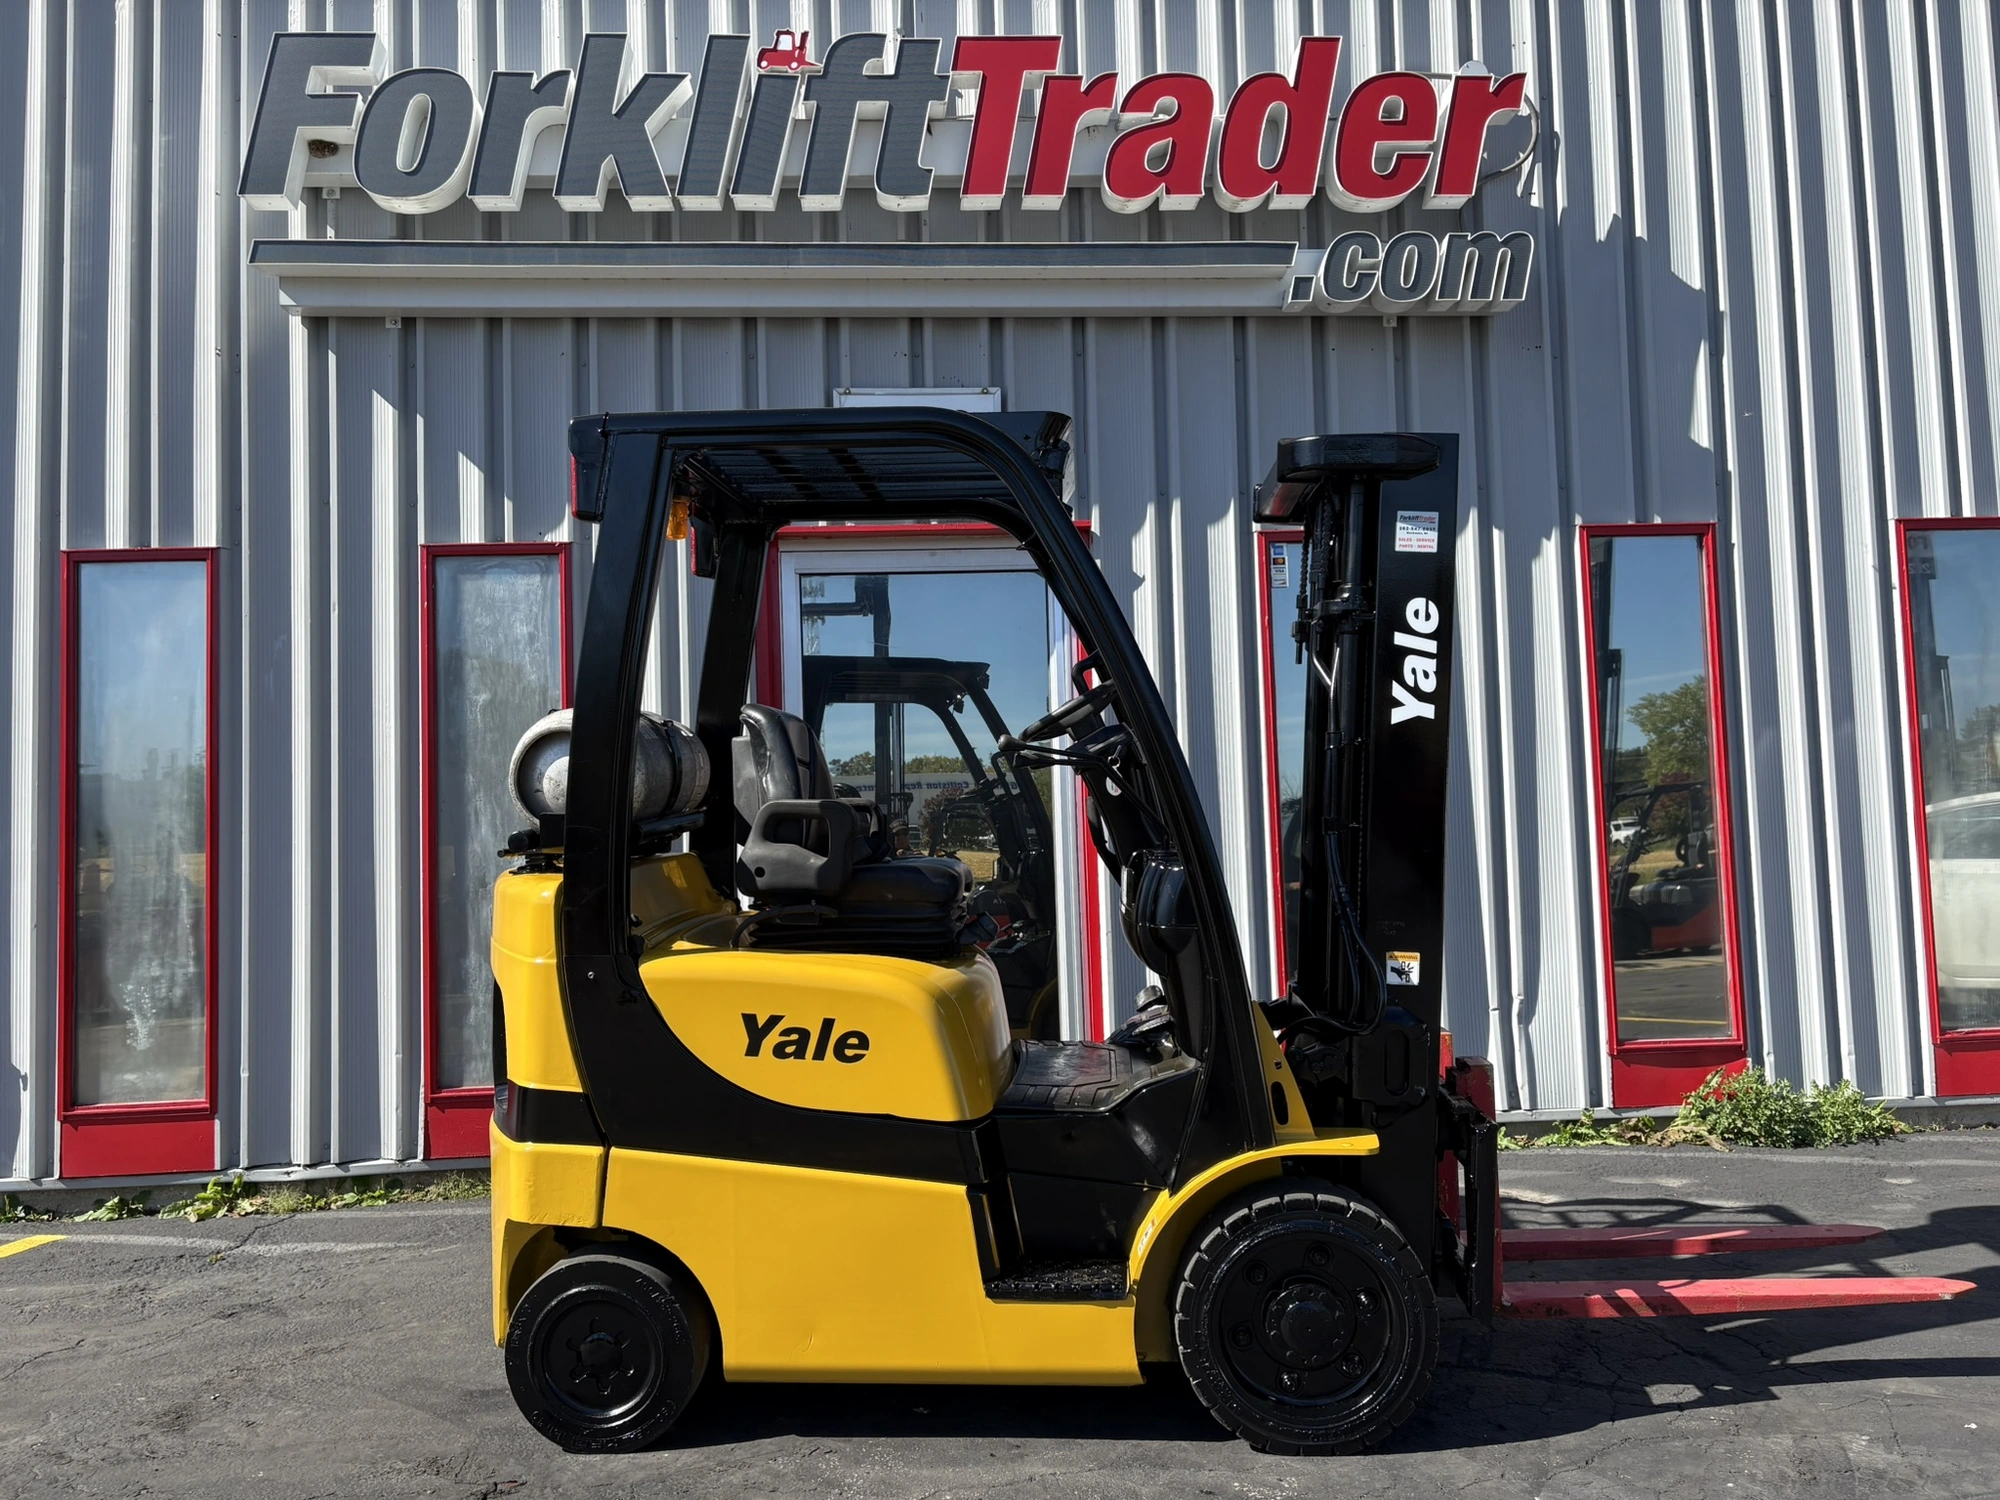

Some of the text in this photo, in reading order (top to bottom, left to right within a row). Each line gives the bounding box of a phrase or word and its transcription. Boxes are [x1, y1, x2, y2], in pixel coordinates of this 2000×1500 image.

[238, 29, 1528, 208] ForkliftTrader
[1286, 229, 1535, 306] .com
[1391, 597, 1440, 725] Yale
[740, 1012, 870, 1064] Yale
